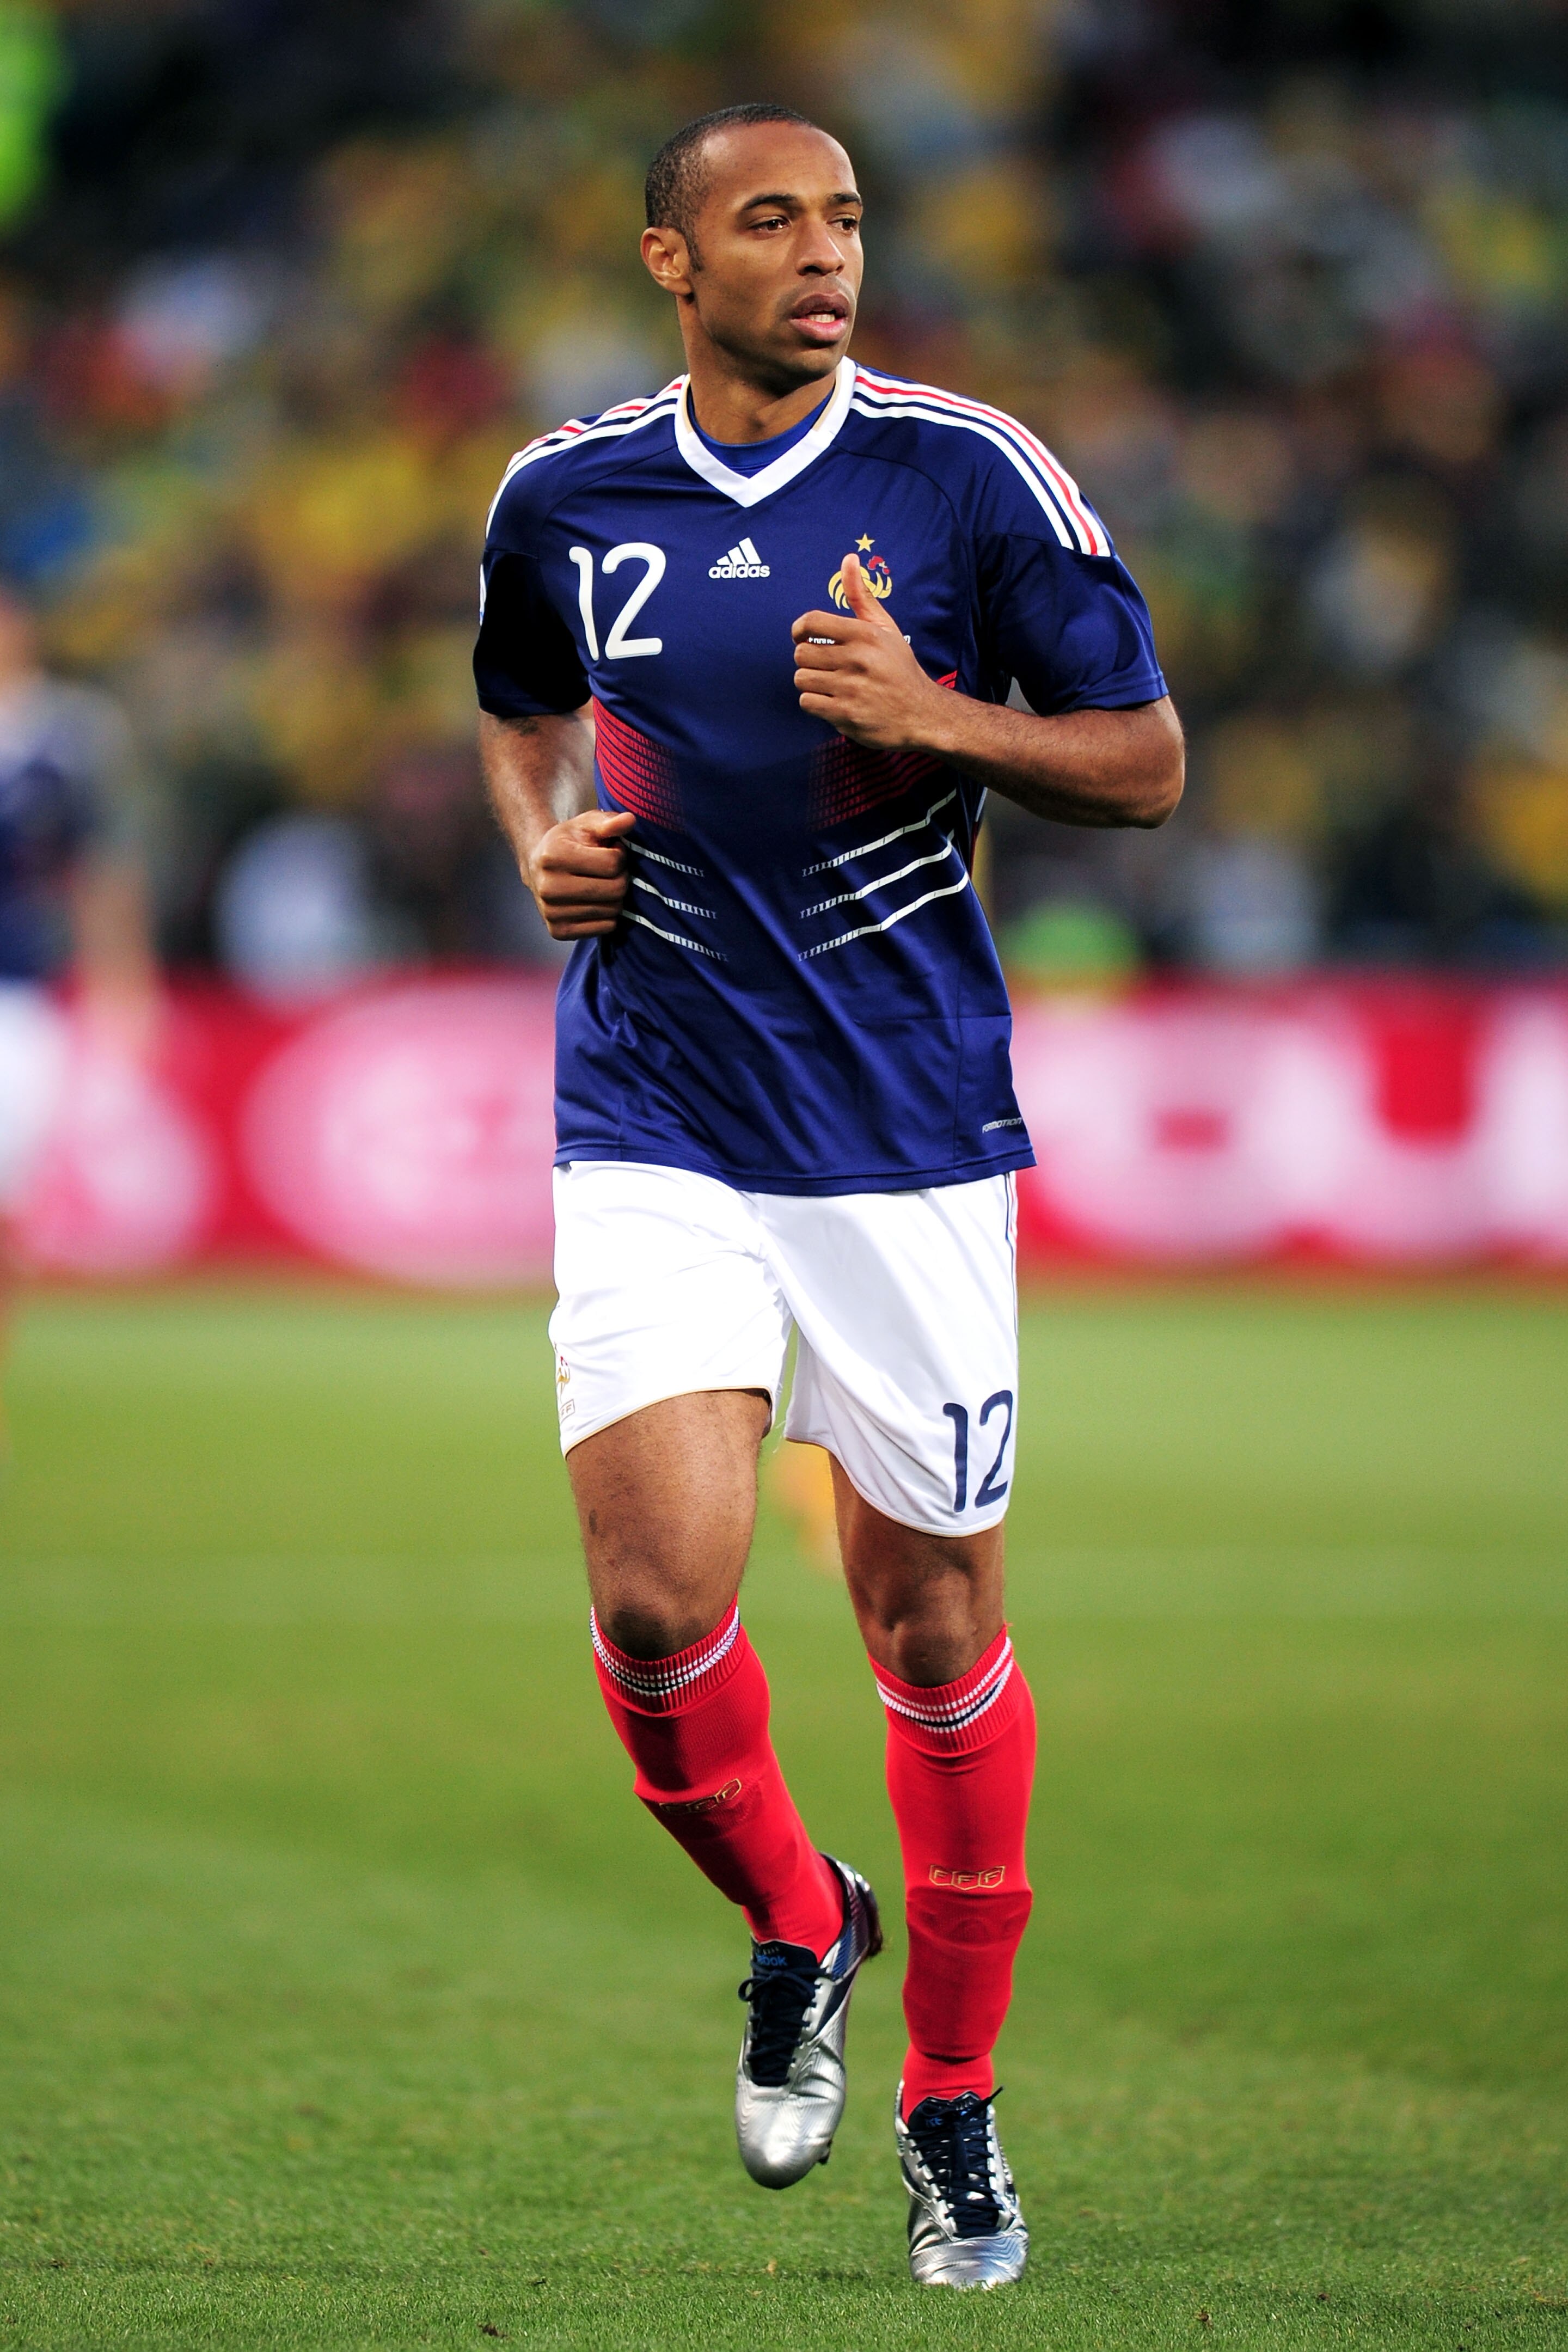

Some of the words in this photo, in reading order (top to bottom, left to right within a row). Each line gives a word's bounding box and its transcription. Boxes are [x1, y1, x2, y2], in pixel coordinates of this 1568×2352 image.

[569, 542, 666, 661] 12
[708, 563, 770, 579] adidas
[942, 1390, 1013, 1513] 12
